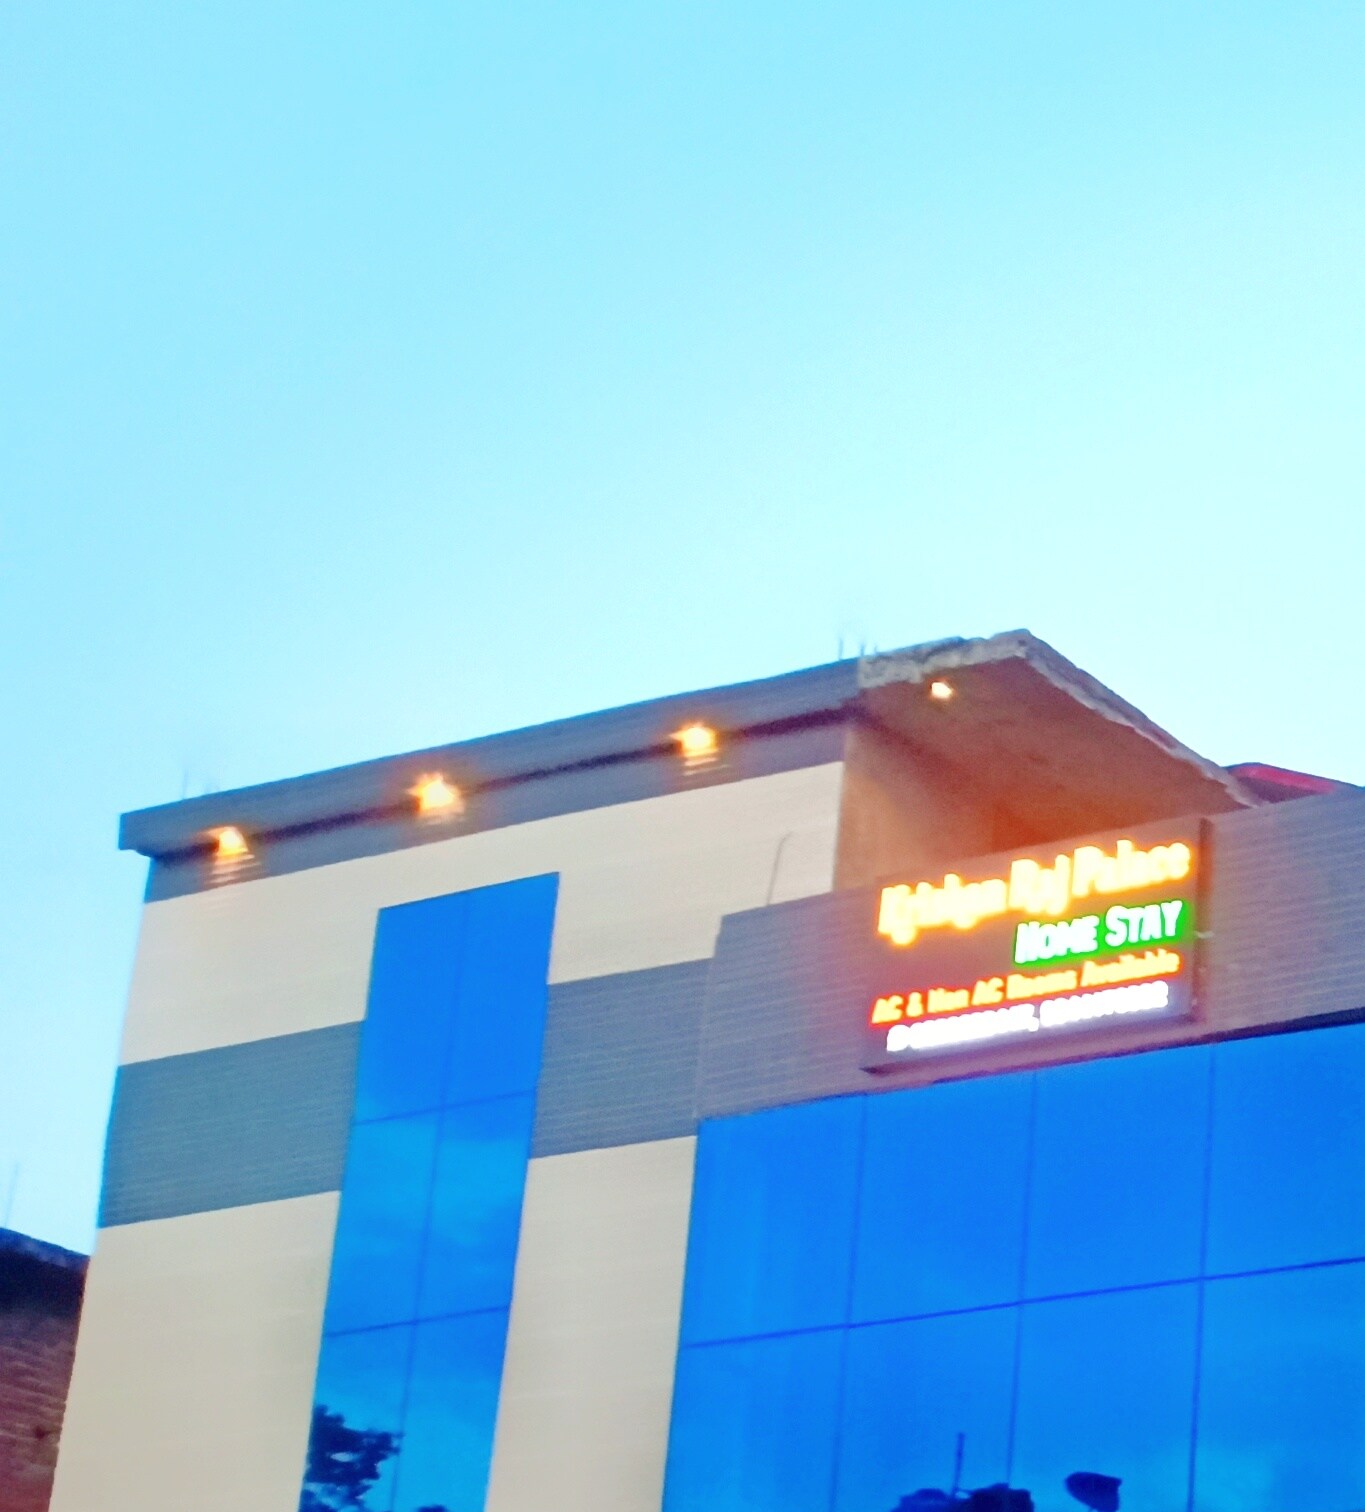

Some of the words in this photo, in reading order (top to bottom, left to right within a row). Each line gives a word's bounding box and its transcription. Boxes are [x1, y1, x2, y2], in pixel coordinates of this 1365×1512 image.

[1008, 855, 1071, 916] Raj
[1073, 840, 1190, 897] Palace
[1015, 915, 1099, 963] HOME
[1105, 901, 1182, 946] STAY
[872, 995, 903, 1023] AC
[972, 977, 1004, 1006] AC
